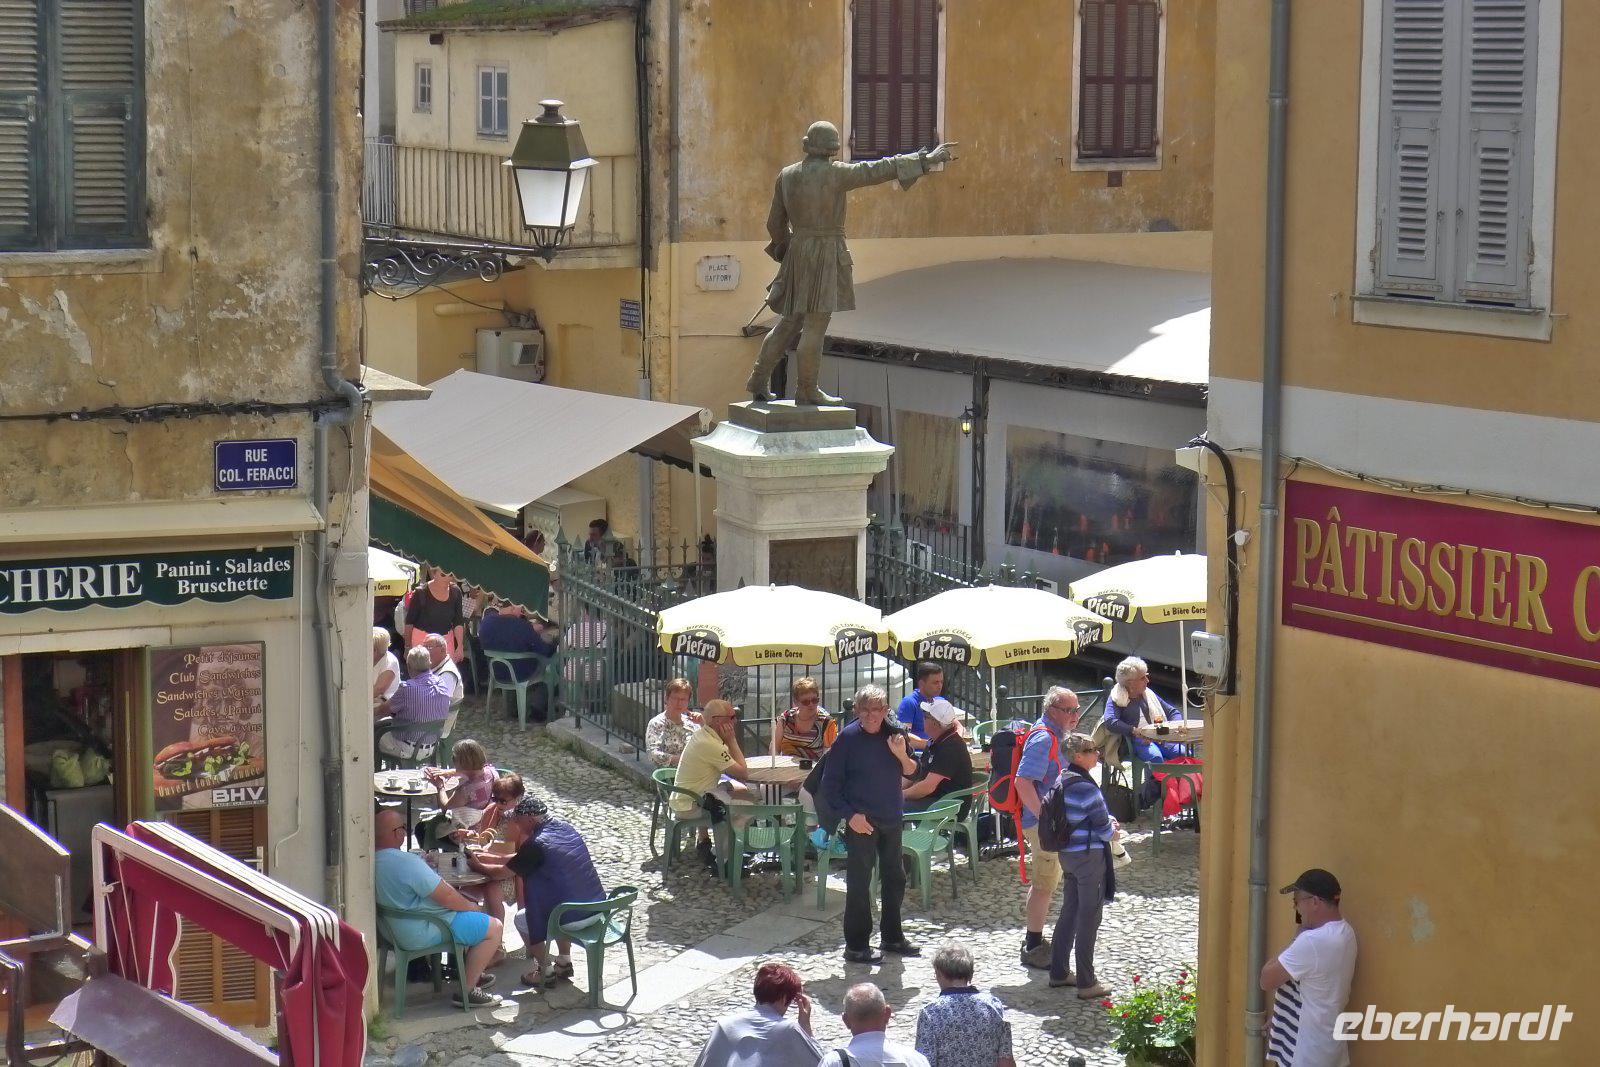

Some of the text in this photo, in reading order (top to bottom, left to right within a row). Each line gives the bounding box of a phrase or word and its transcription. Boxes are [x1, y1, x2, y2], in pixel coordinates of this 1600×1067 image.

[245, 448, 268, 463] RUE
[219, 466, 294, 483] COL. FERACCI
[156, 557, 291, 578] Panini Salades
[1292, 506, 1553, 634] PÂTISSIER
[177, 577, 268, 595] Bruschette
[1087, 598, 1125, 619] Pietra
[1191, 605, 1208, 614] Cors
[676, 634, 718, 659] Pietra
[755, 650, 763, 659] La
[764, 648, 783, 659] Bière
[838, 635, 873, 659] Pietra
[918, 641, 966, 662] Pietra
[1014, 647, 1031, 657] Bière
[169, 668, 261, 685] Club Sandwiches
[156, 685, 261, 705] Sandwiches Maison
[158, 780, 191, 798] Ouvert
[212, 786, 264, 803] BHV
